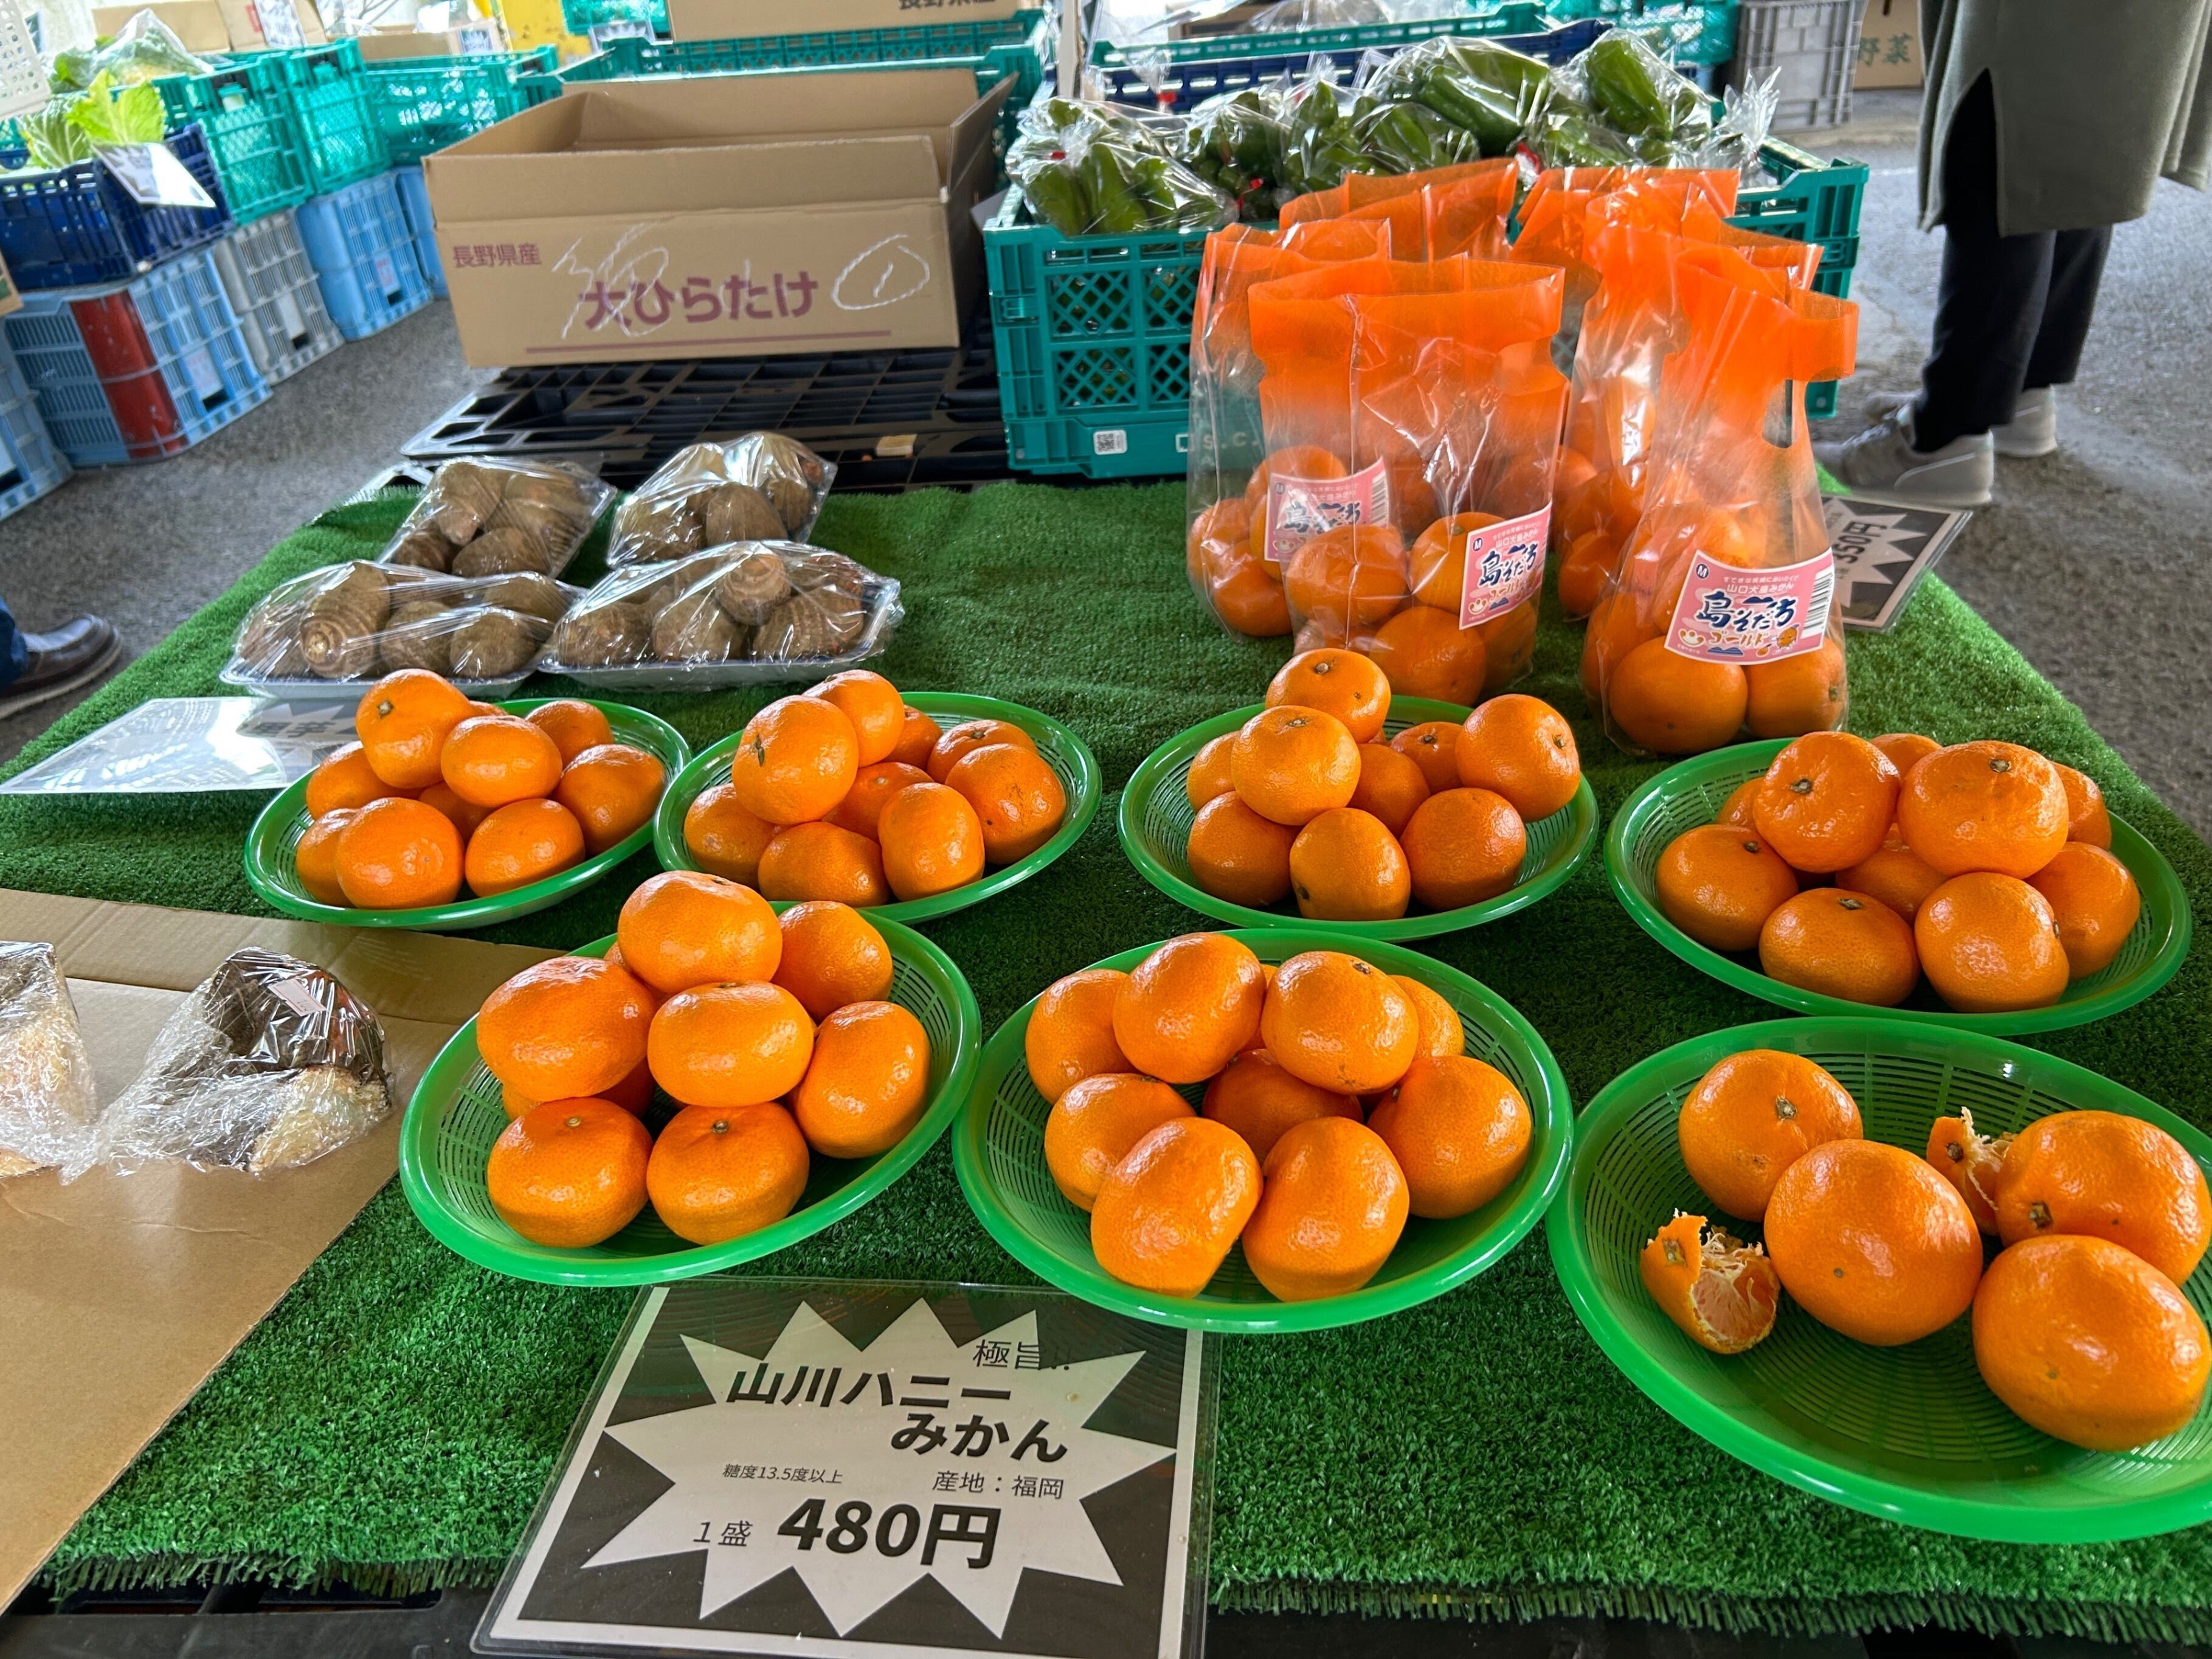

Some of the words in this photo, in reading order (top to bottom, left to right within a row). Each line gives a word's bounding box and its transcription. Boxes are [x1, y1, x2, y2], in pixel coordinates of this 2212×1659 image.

[453, 243, 542, 268] 長野県産
[579, 271, 818, 330] 大ひらたけ
[1832, 521, 1887, 564] 350円
[1726, 582, 1794, 594] 山口大島みかん
[1695, 591, 1797, 632] 島そだち
[1709, 630, 1770, 646] ゴールド
[973, 1339, 1070, 1371] 極旨
[725, 1362, 1011, 1409] 山川ハニー
[890, 1412, 1068, 1463] みかん
[722, 1463, 843, 1484] 糖度13.5度以上
[931, 1470, 1065, 1500] 産地：福岡
[776, 1498, 1002, 1570] 480円
